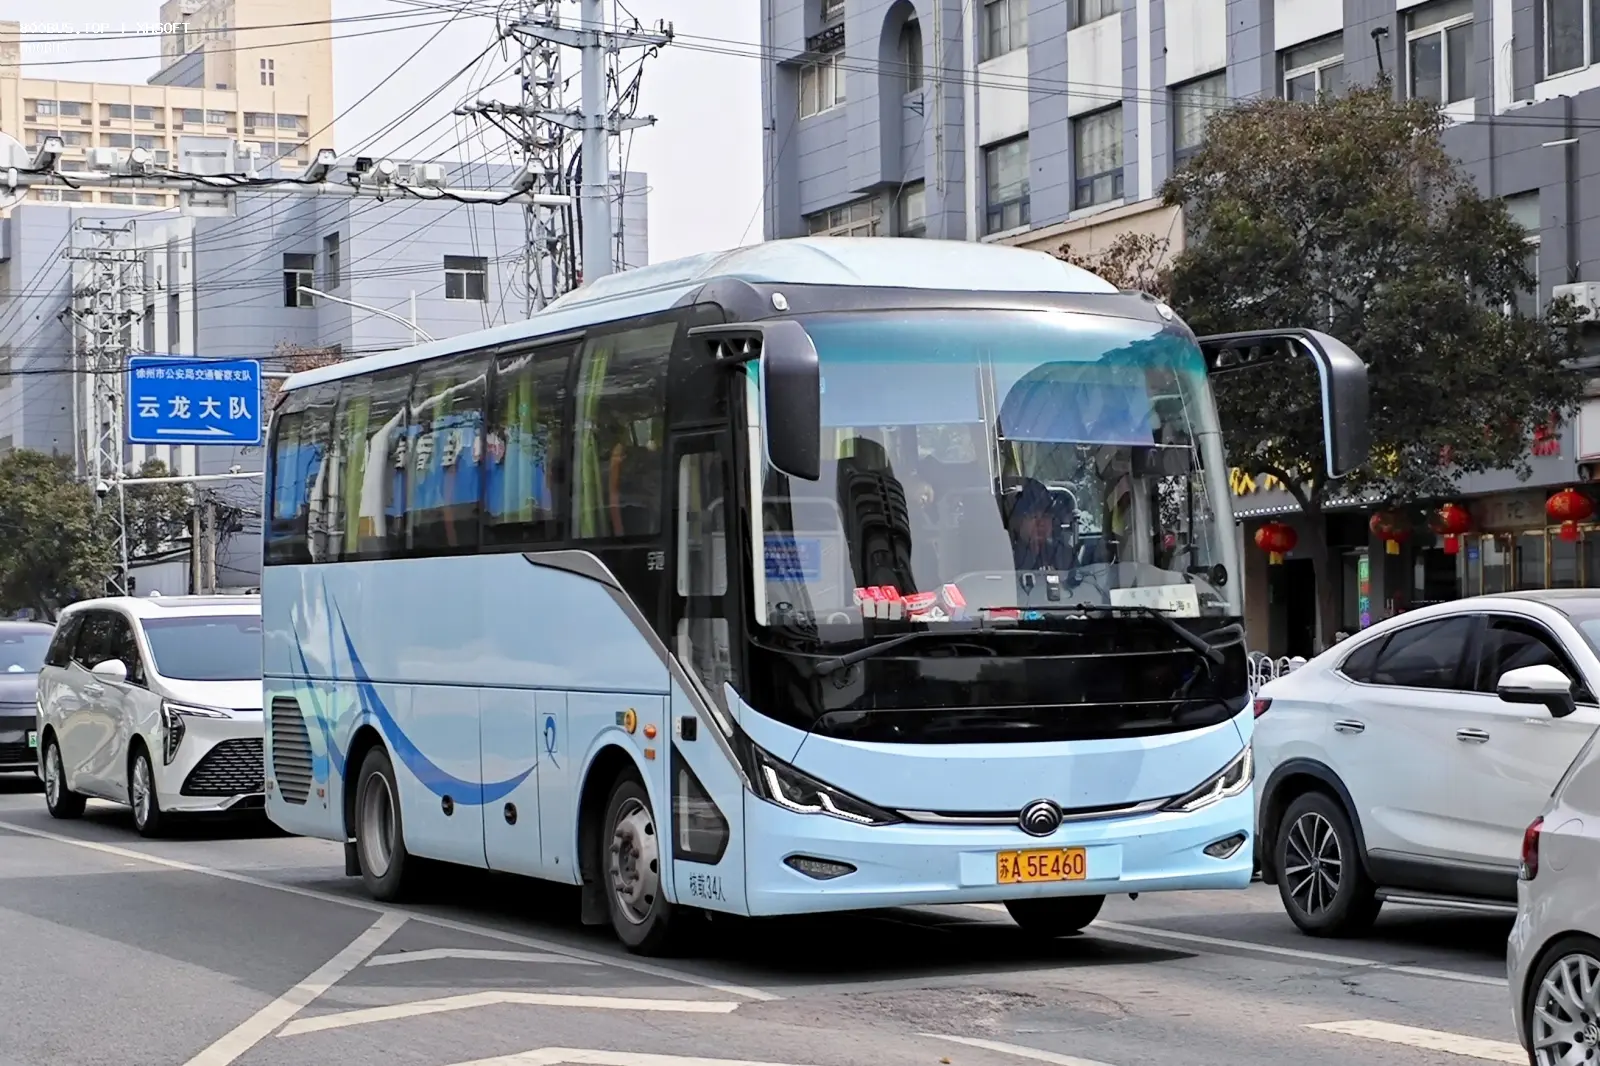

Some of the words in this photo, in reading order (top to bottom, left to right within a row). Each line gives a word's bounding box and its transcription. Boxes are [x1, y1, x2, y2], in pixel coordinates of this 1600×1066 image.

[136, 368, 252, 382] 徐州市公安局交通警察支队
[137, 396, 252, 419] 云龙大队
